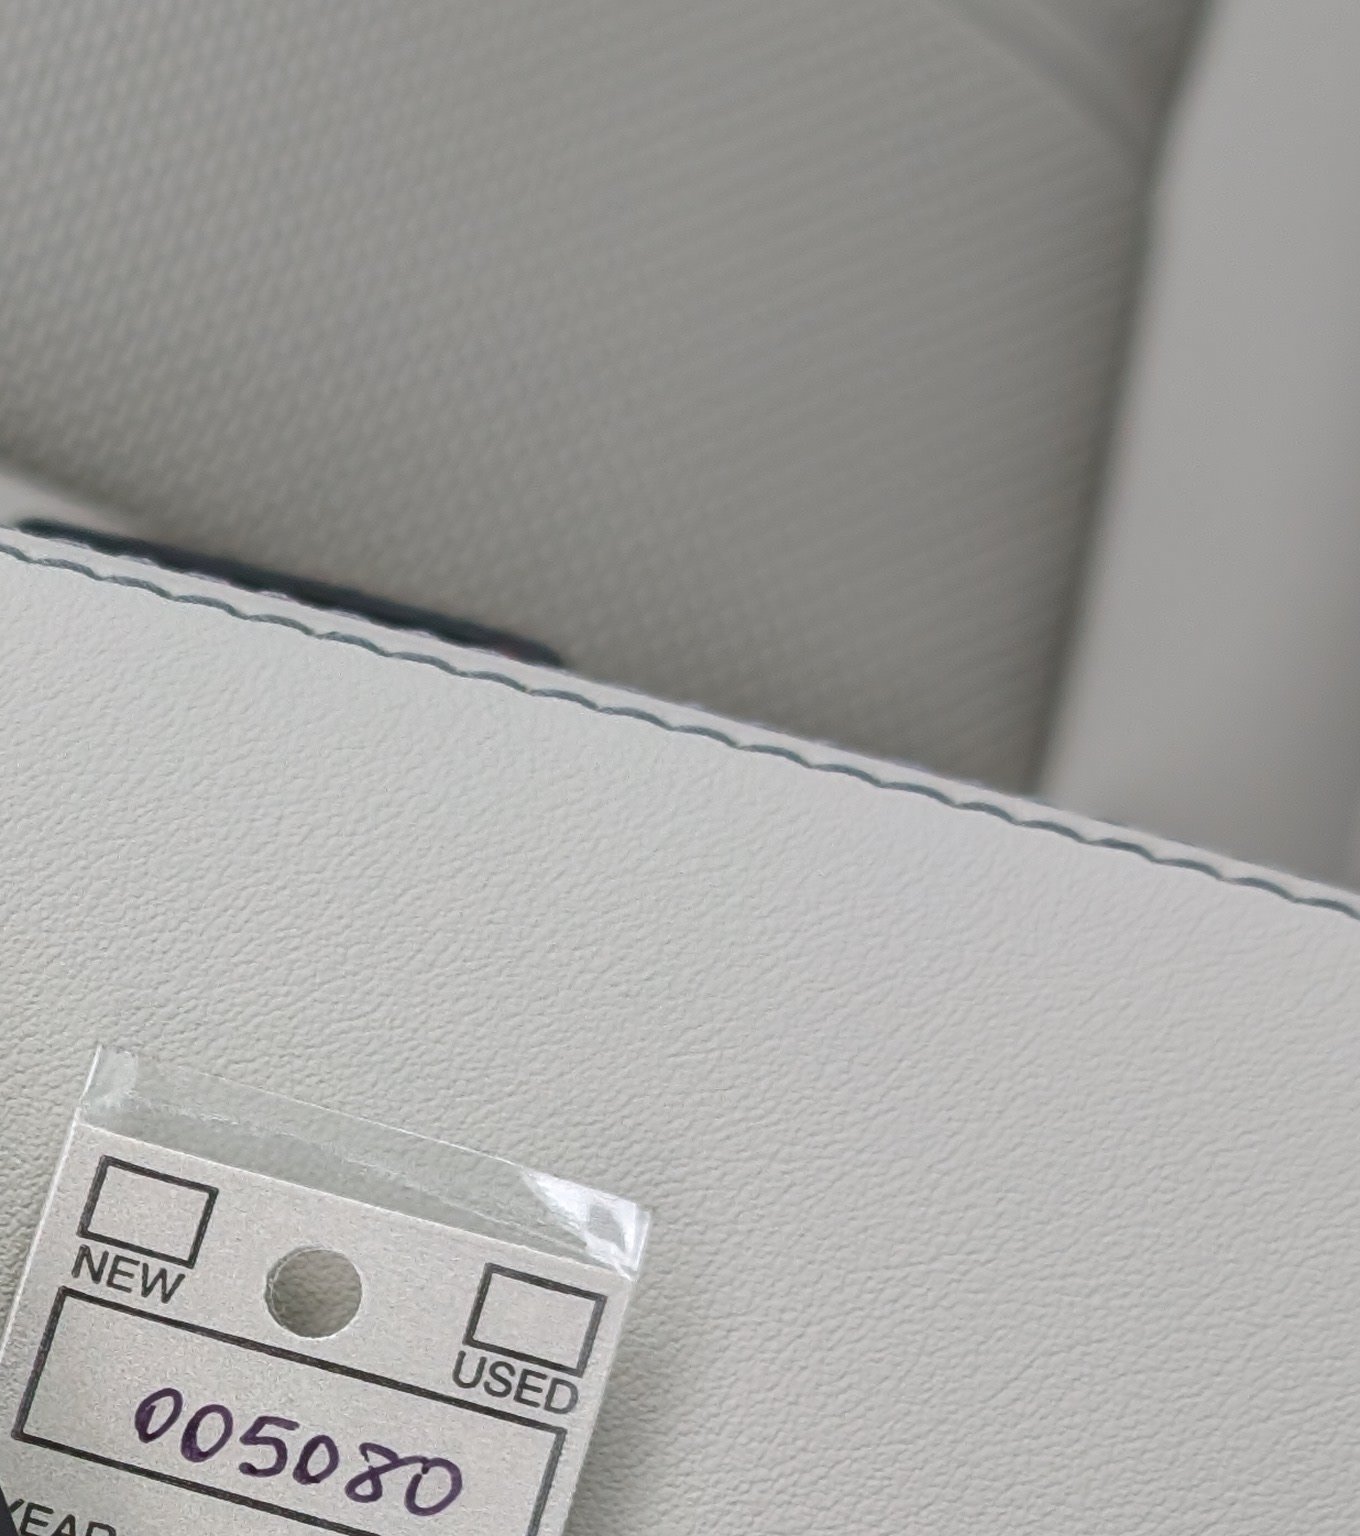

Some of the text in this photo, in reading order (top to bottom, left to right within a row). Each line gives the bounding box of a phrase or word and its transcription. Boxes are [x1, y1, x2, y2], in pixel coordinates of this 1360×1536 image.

[72, 1245, 186, 1303] NEW
[453, 1351, 579, 1416] USED
[134, 1387, 463, 1516] 005080
